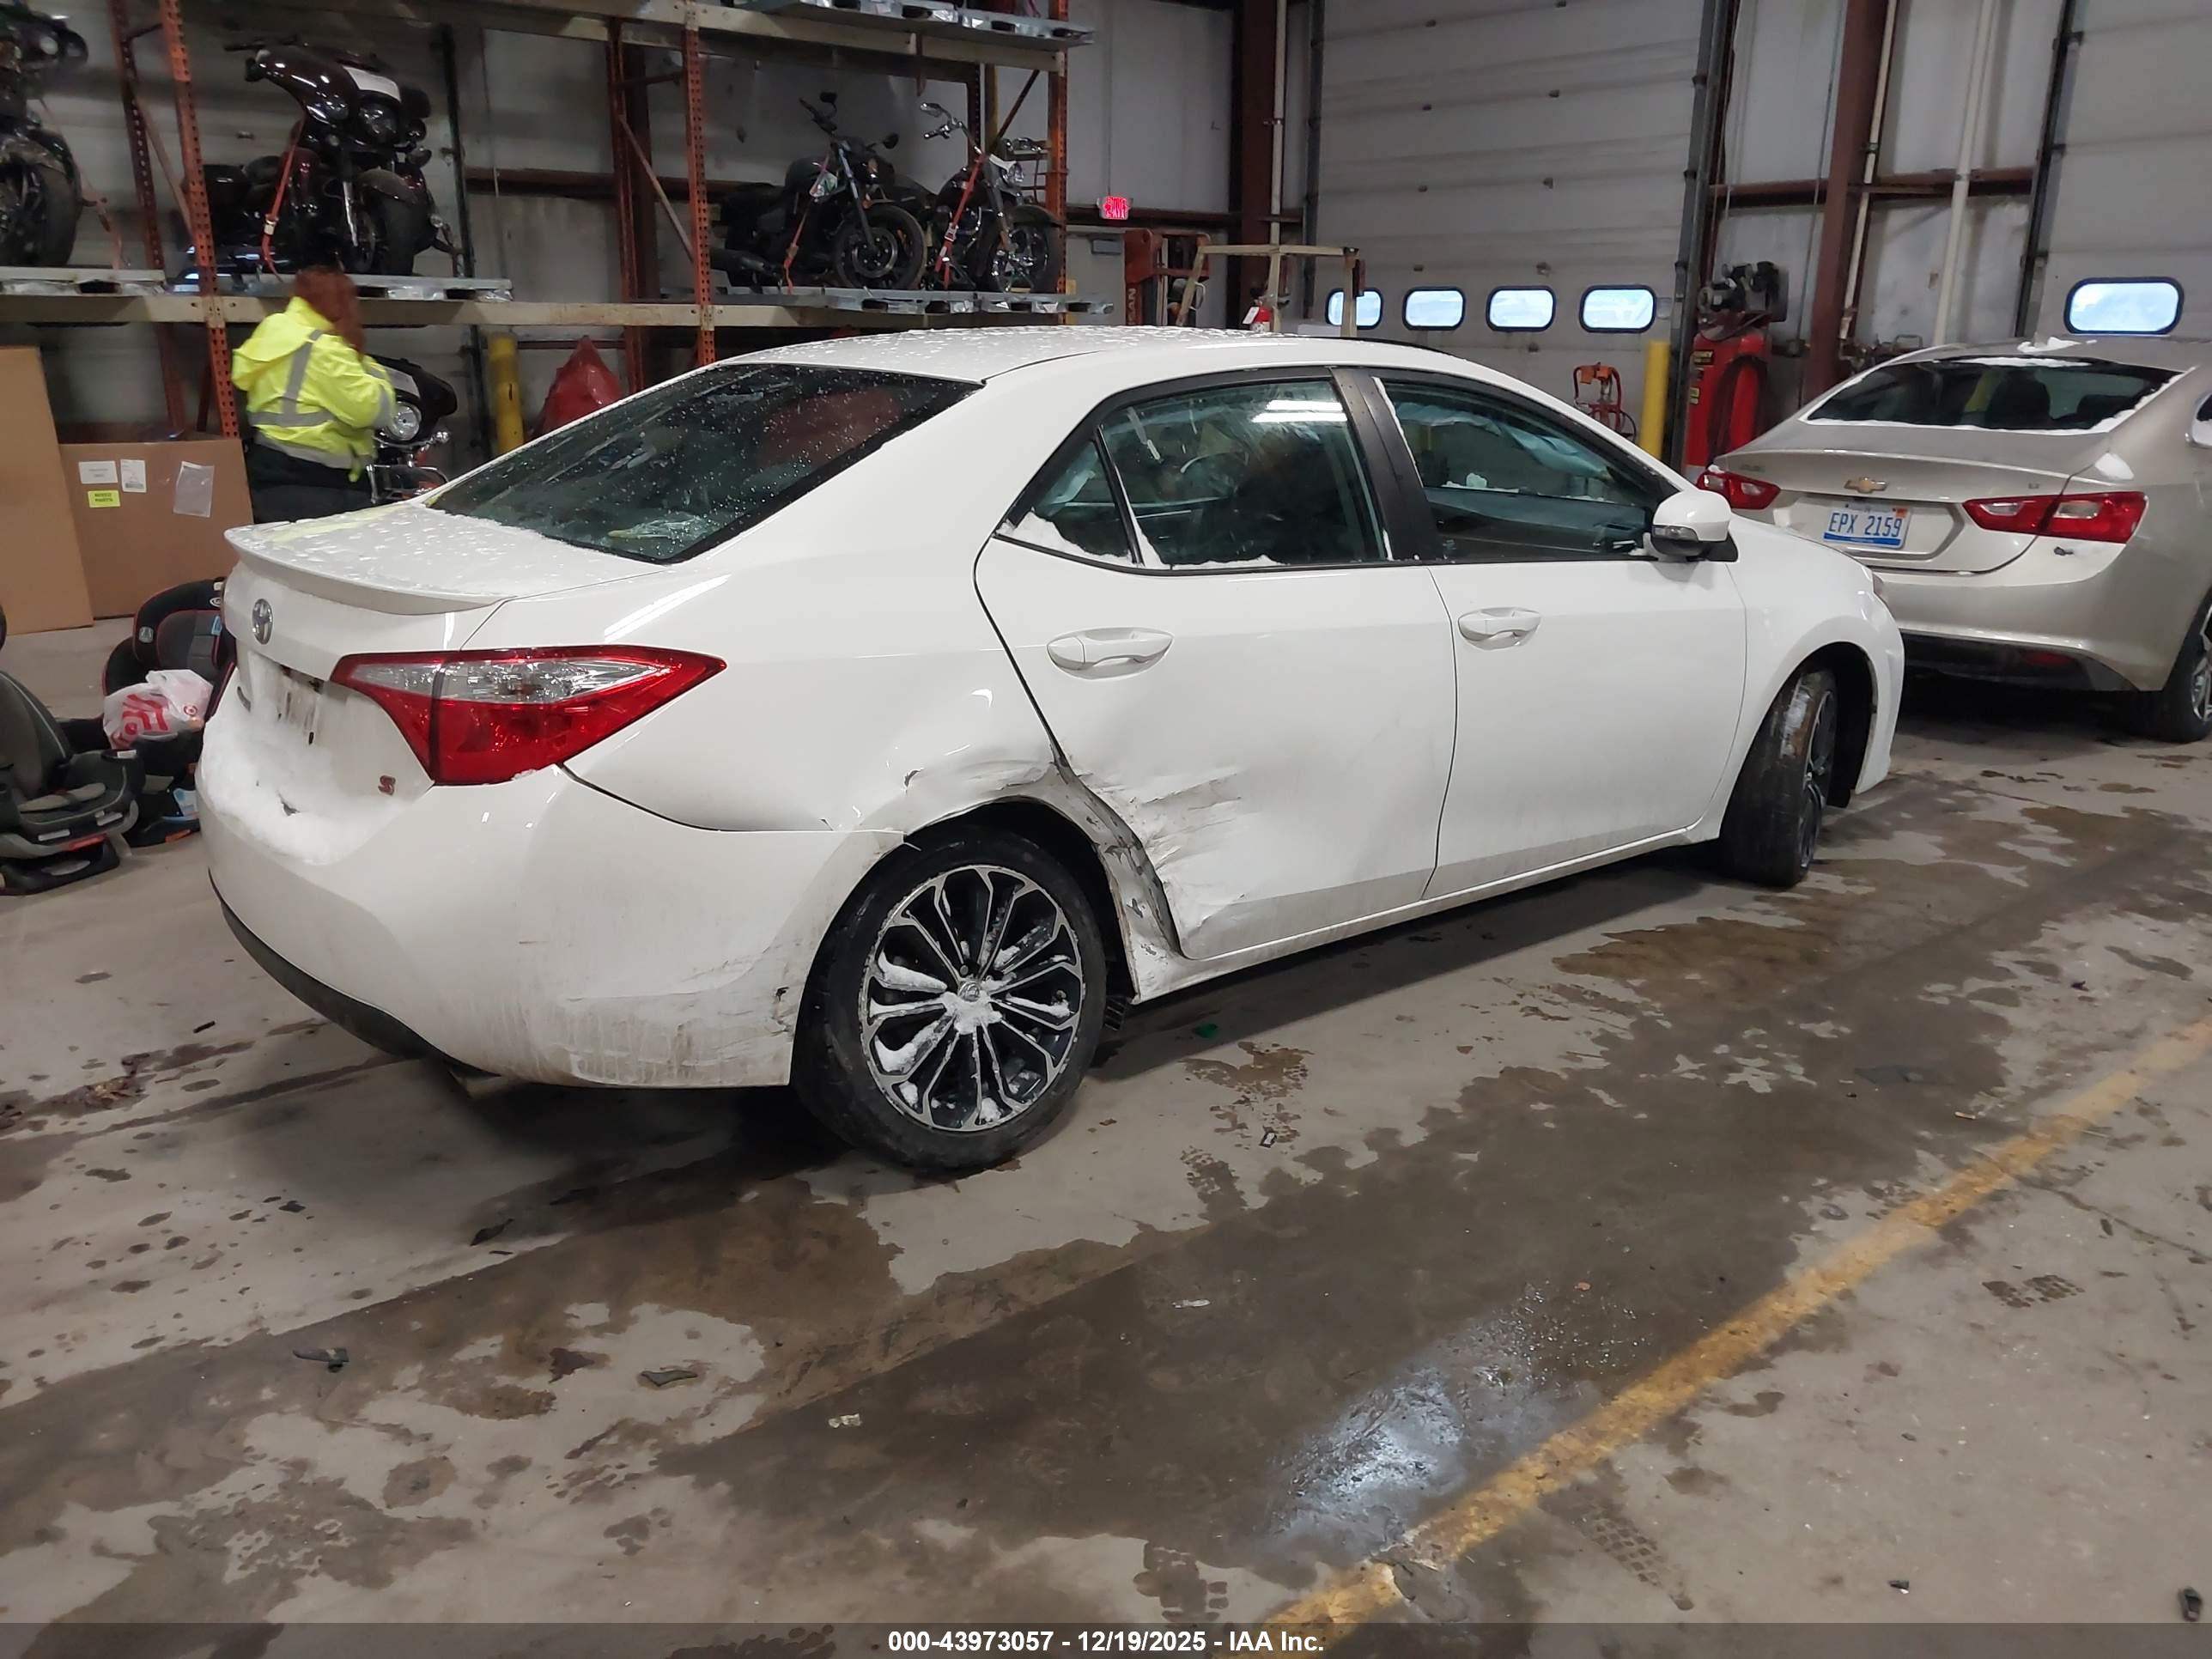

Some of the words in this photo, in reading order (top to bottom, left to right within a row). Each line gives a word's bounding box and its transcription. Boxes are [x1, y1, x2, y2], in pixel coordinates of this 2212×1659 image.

[1828, 513, 1858, 533] EPX
[1864, 515, 1903, 538] 2159
[378, 775, 396, 796] S
